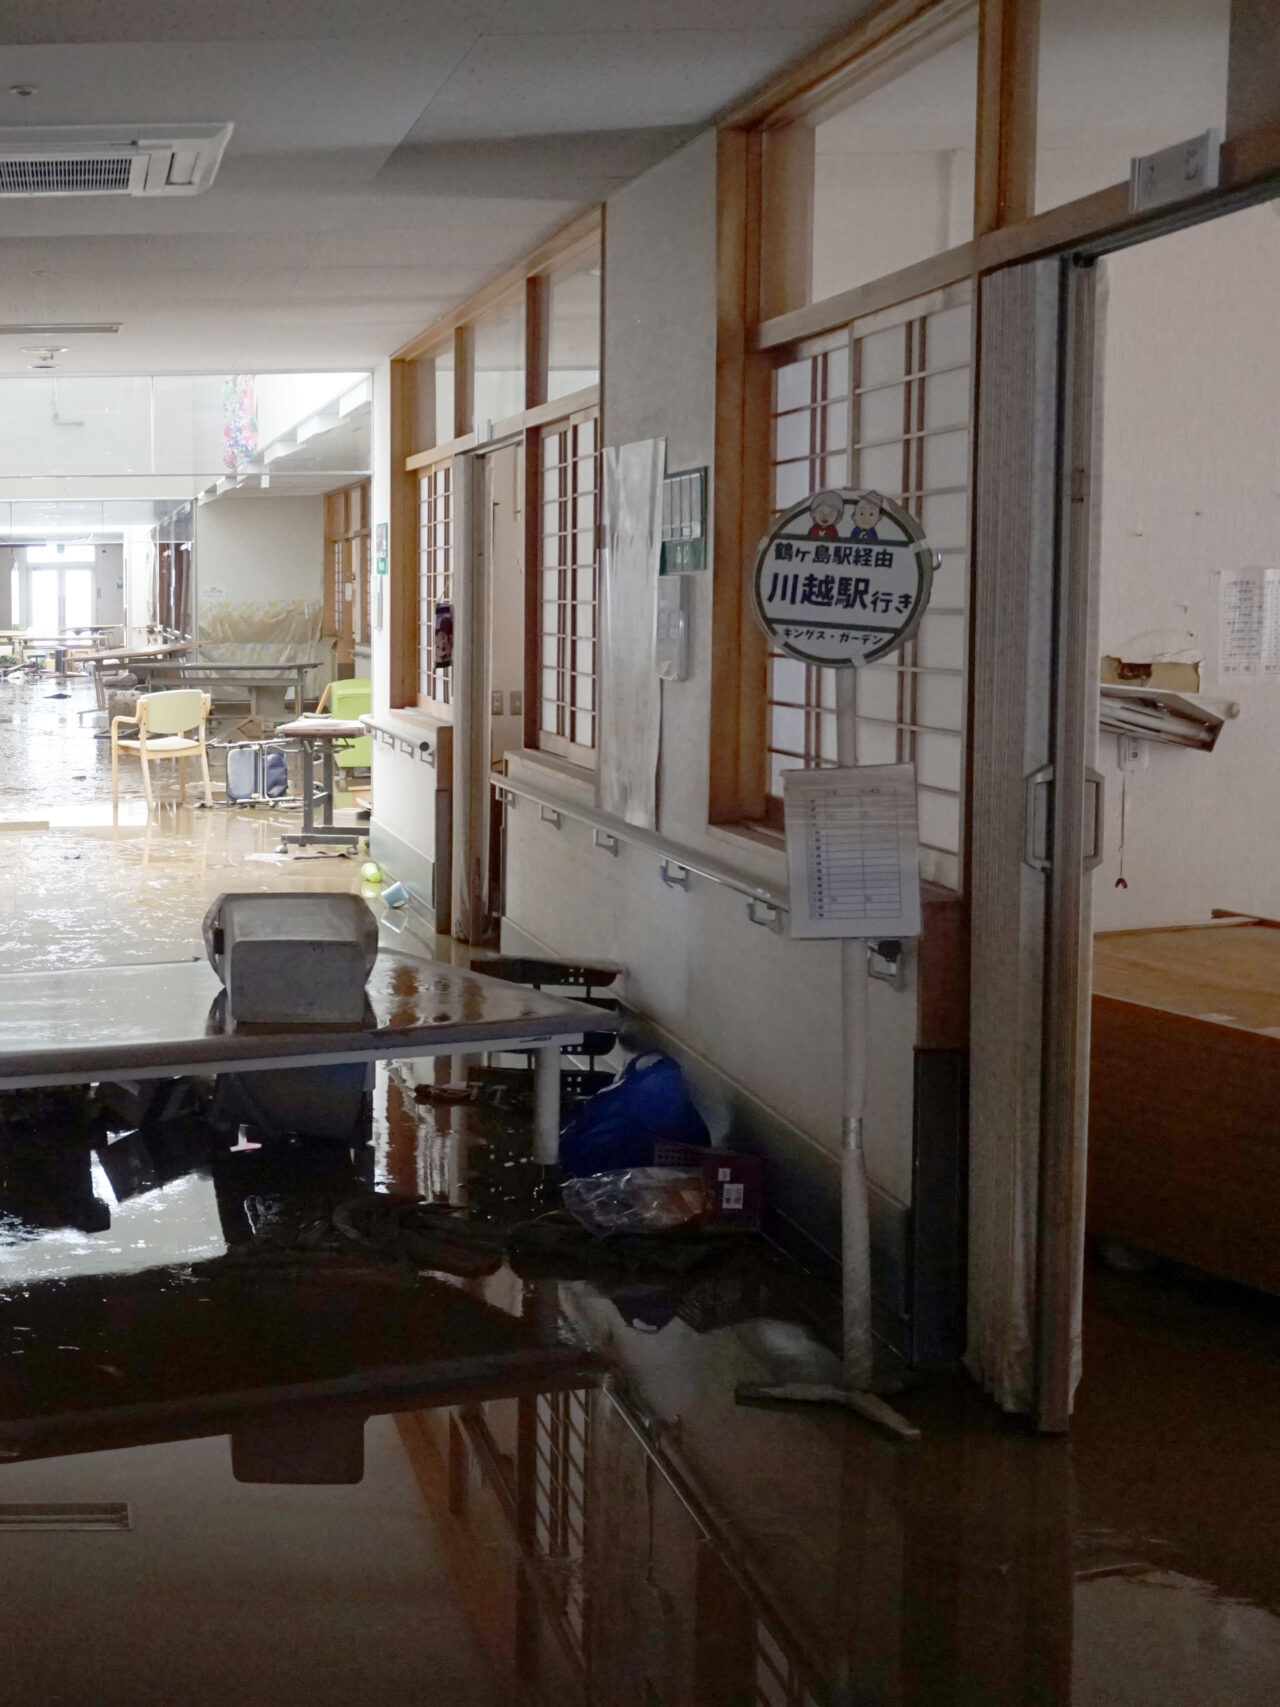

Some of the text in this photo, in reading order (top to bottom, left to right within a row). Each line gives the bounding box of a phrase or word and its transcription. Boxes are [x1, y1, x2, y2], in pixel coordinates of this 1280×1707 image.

[767, 572, 913, 613] 川越駅行き
